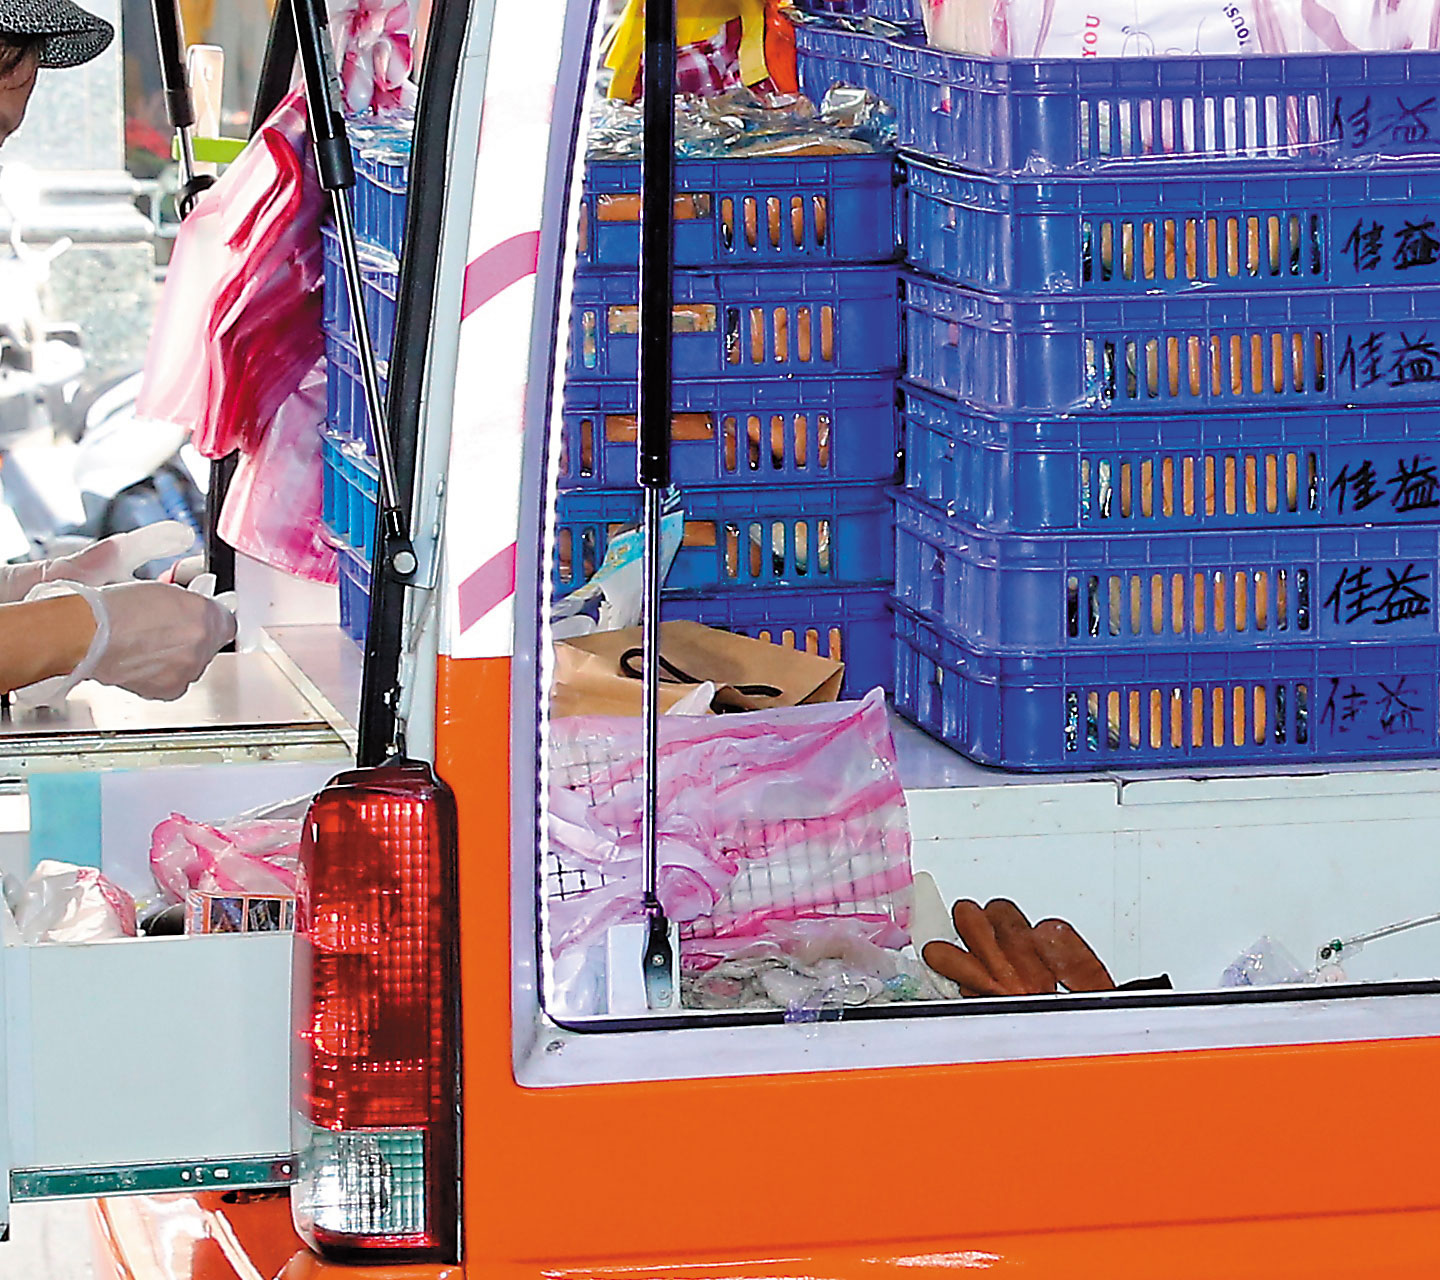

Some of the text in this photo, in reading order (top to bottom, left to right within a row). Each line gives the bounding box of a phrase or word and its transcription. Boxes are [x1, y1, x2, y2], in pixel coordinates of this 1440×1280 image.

[1340, 217, 1440, 273] 佳益
[1329, 453, 1440, 515] 佳益
[1323, 563, 1431, 624] 佳益
